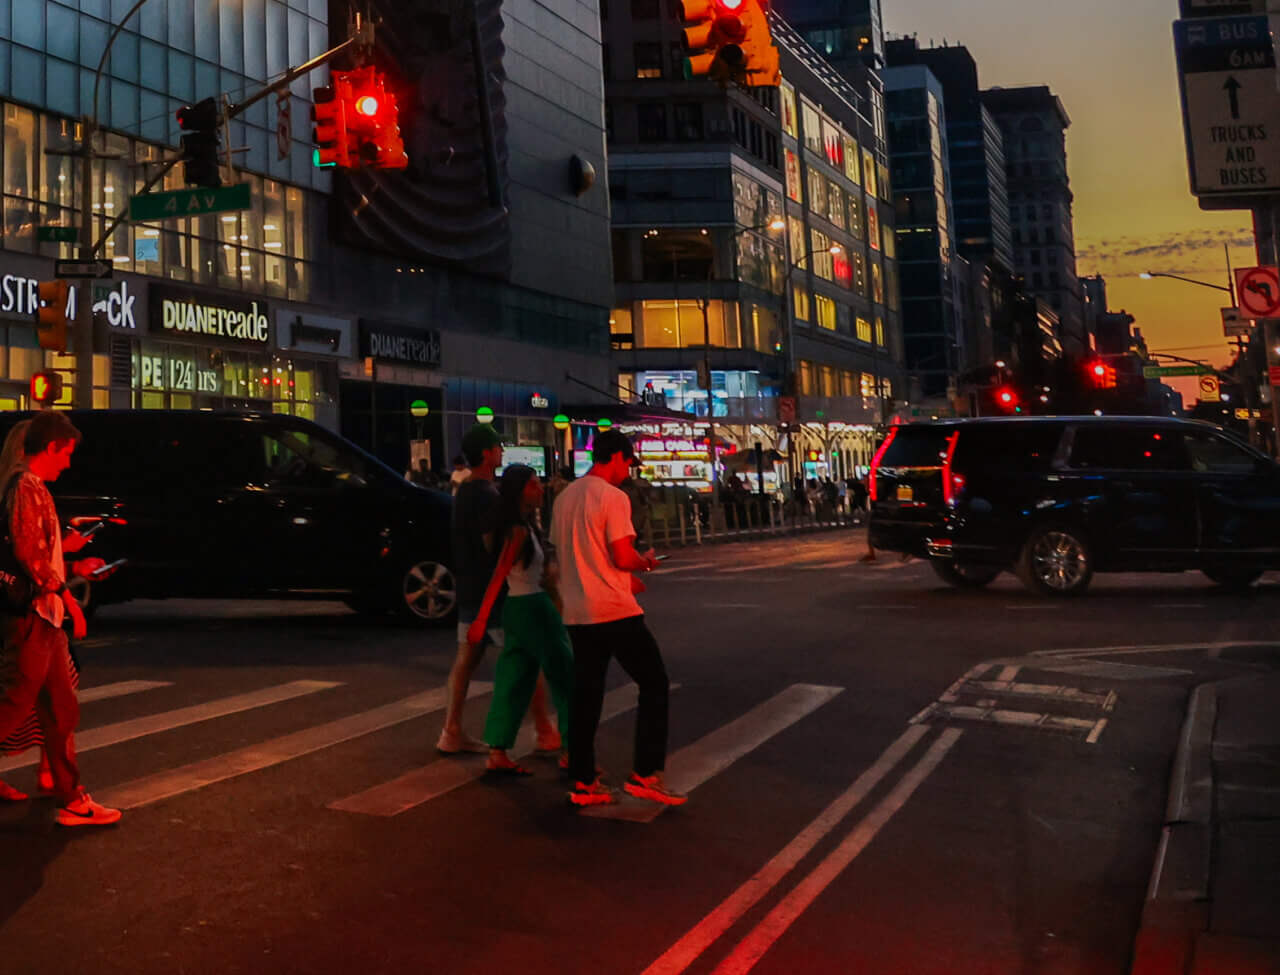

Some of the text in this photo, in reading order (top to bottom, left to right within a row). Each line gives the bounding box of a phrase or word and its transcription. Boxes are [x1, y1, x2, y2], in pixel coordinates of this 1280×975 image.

[1219, 22, 1258, 41] BUS
[1210, 124, 1268, 143] TRUCKS
[1225, 146, 1256, 164] AND
[1219, 167, 1268, 186] BUSES
[164, 196, 177, 212] 4
